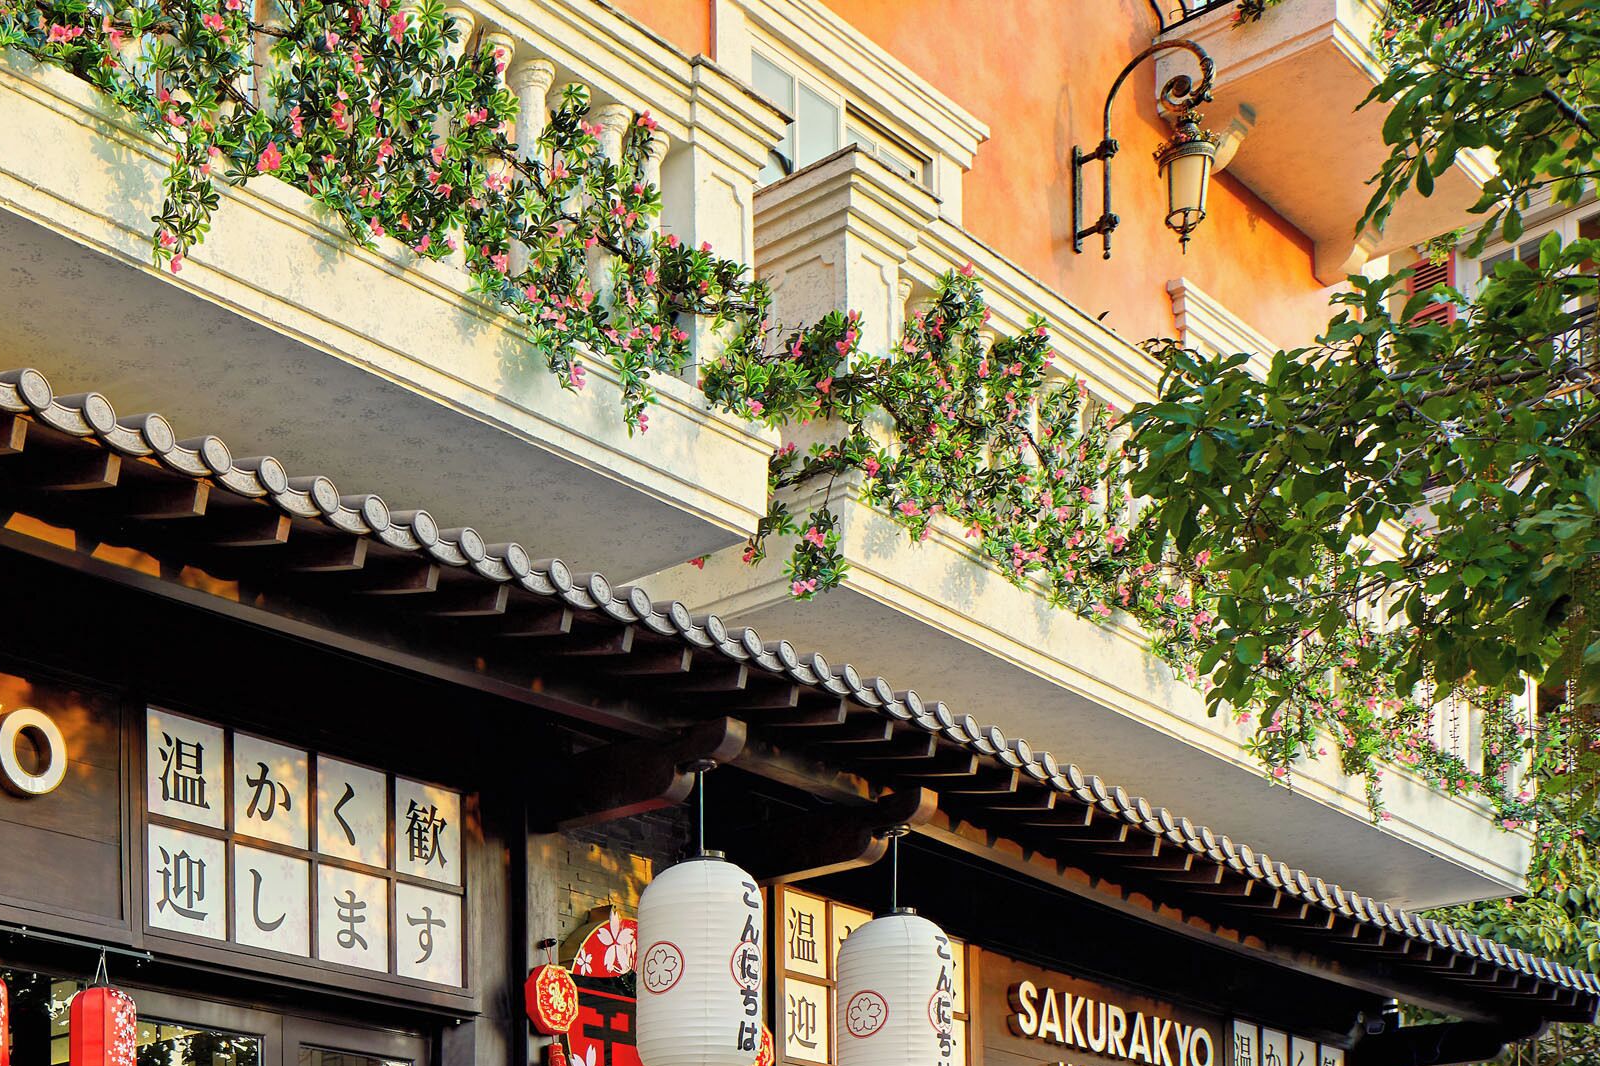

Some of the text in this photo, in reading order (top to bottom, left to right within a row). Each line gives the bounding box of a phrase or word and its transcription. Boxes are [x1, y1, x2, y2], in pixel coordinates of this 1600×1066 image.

[737, 881, 759, 1051] こんにちは
